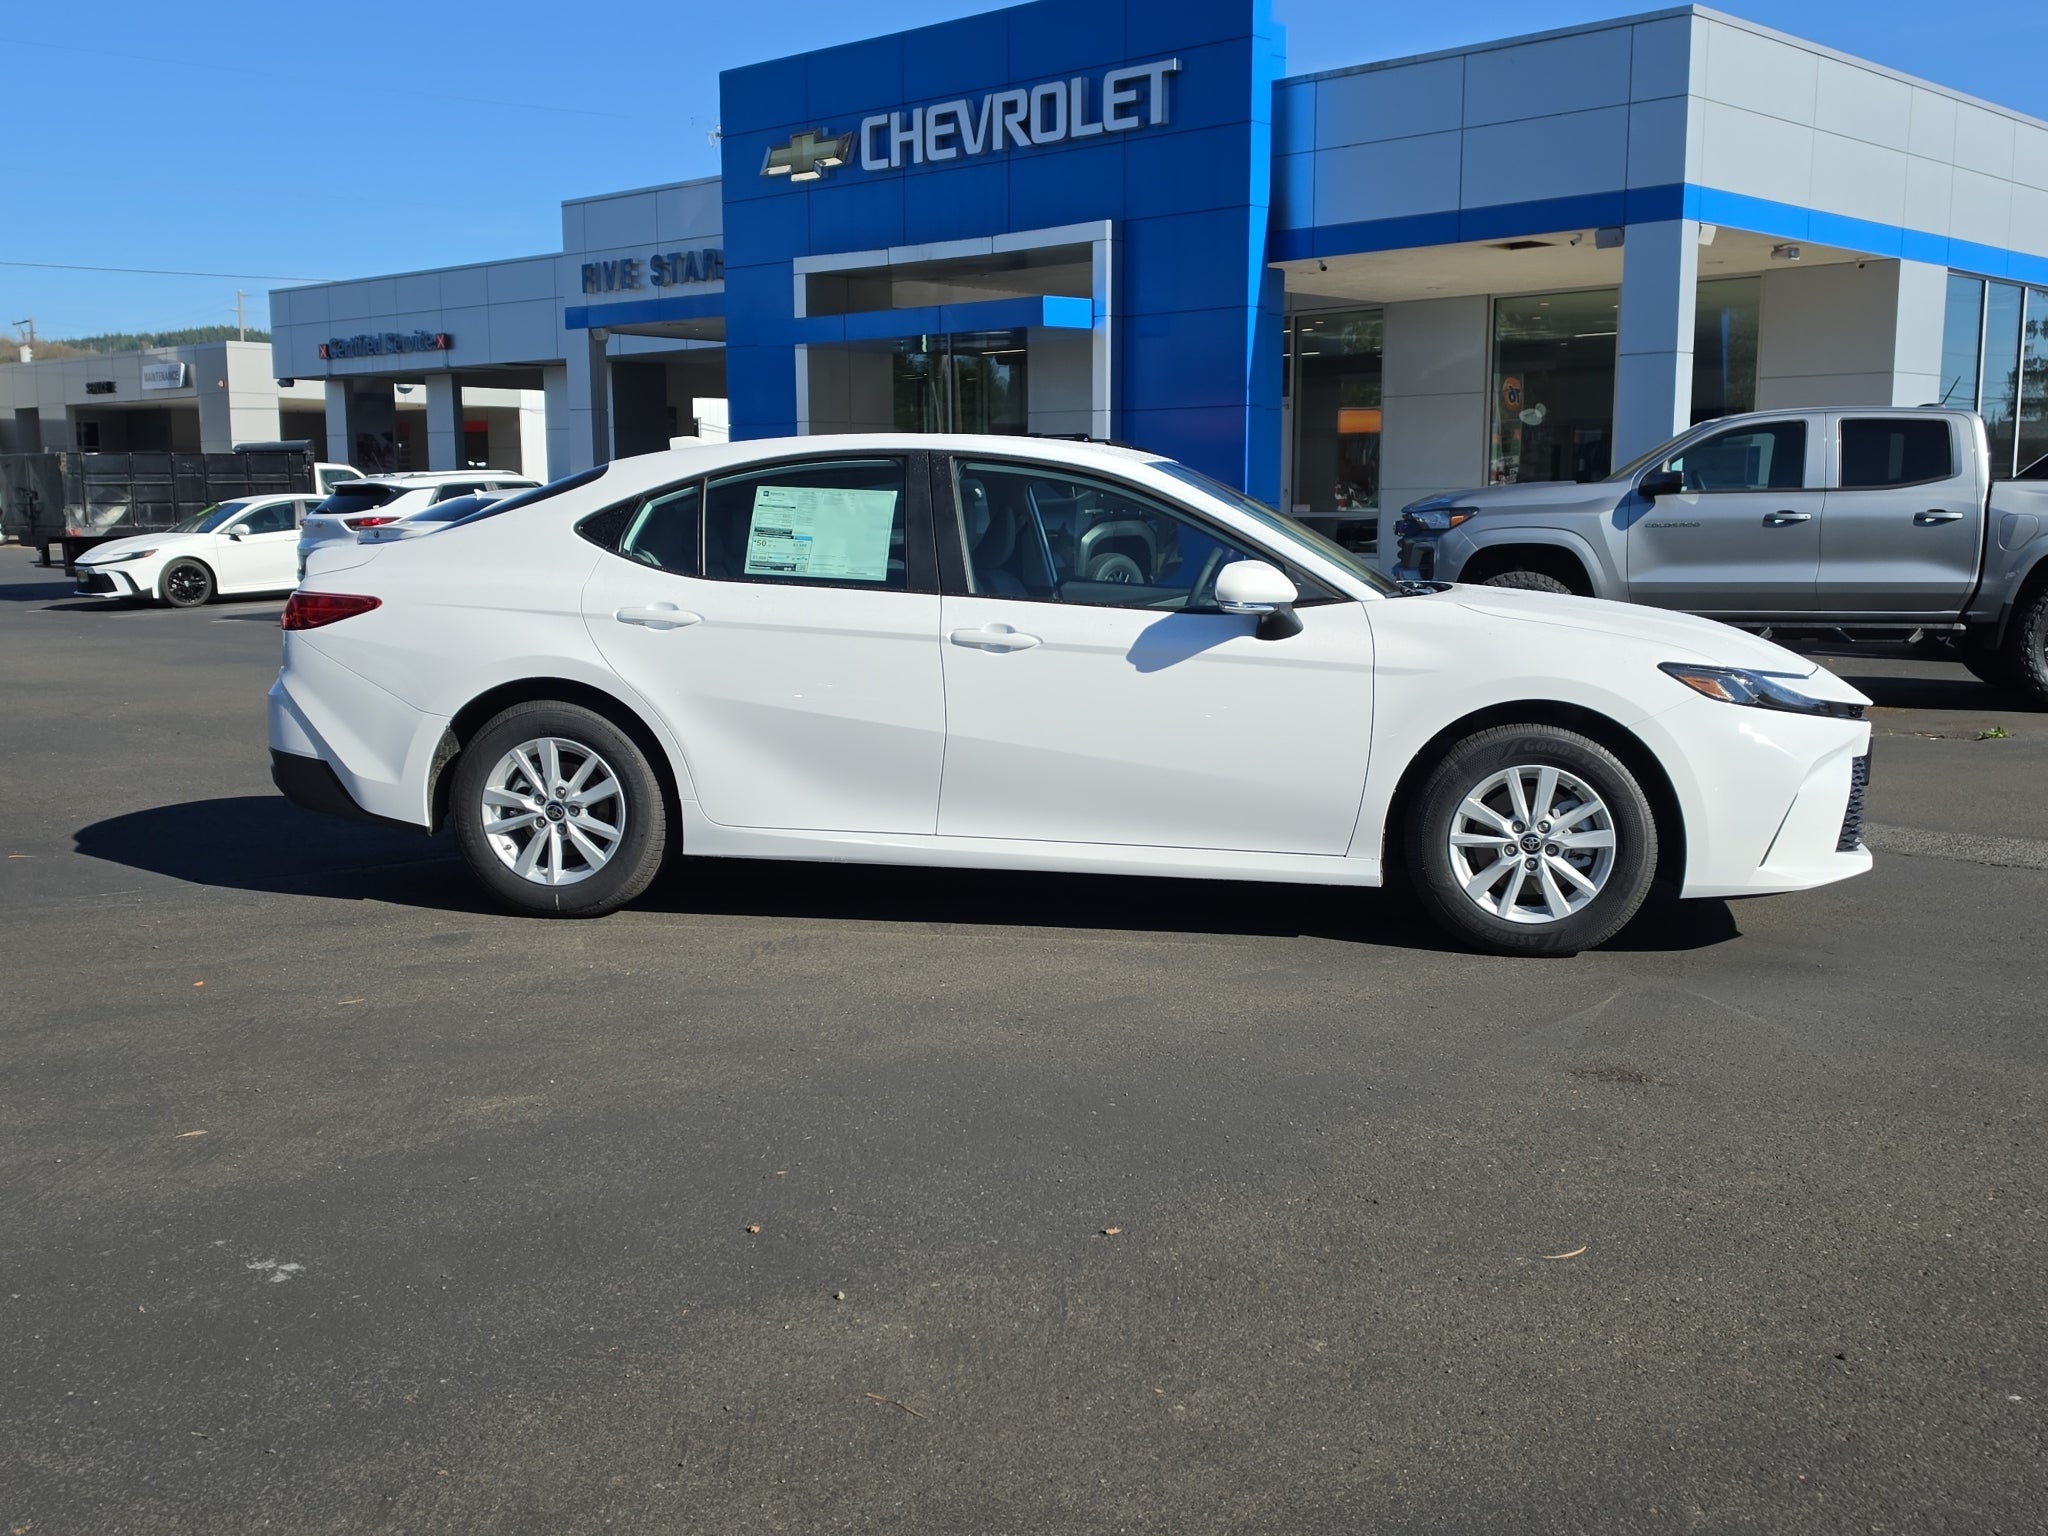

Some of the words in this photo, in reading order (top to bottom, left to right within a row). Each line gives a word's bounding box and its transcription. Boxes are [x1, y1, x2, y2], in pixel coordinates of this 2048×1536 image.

[861, 58, 1181, 171] CHEVROLET
[581, 258, 638, 293] FIVE
[650, 249, 723, 287] STAR
[329, 333, 383, 359] Certified
[385, 330, 435, 354] Service
[143, 370, 180, 383] MAINTENANCE
[1644, 521, 1701, 529] COLORADO
